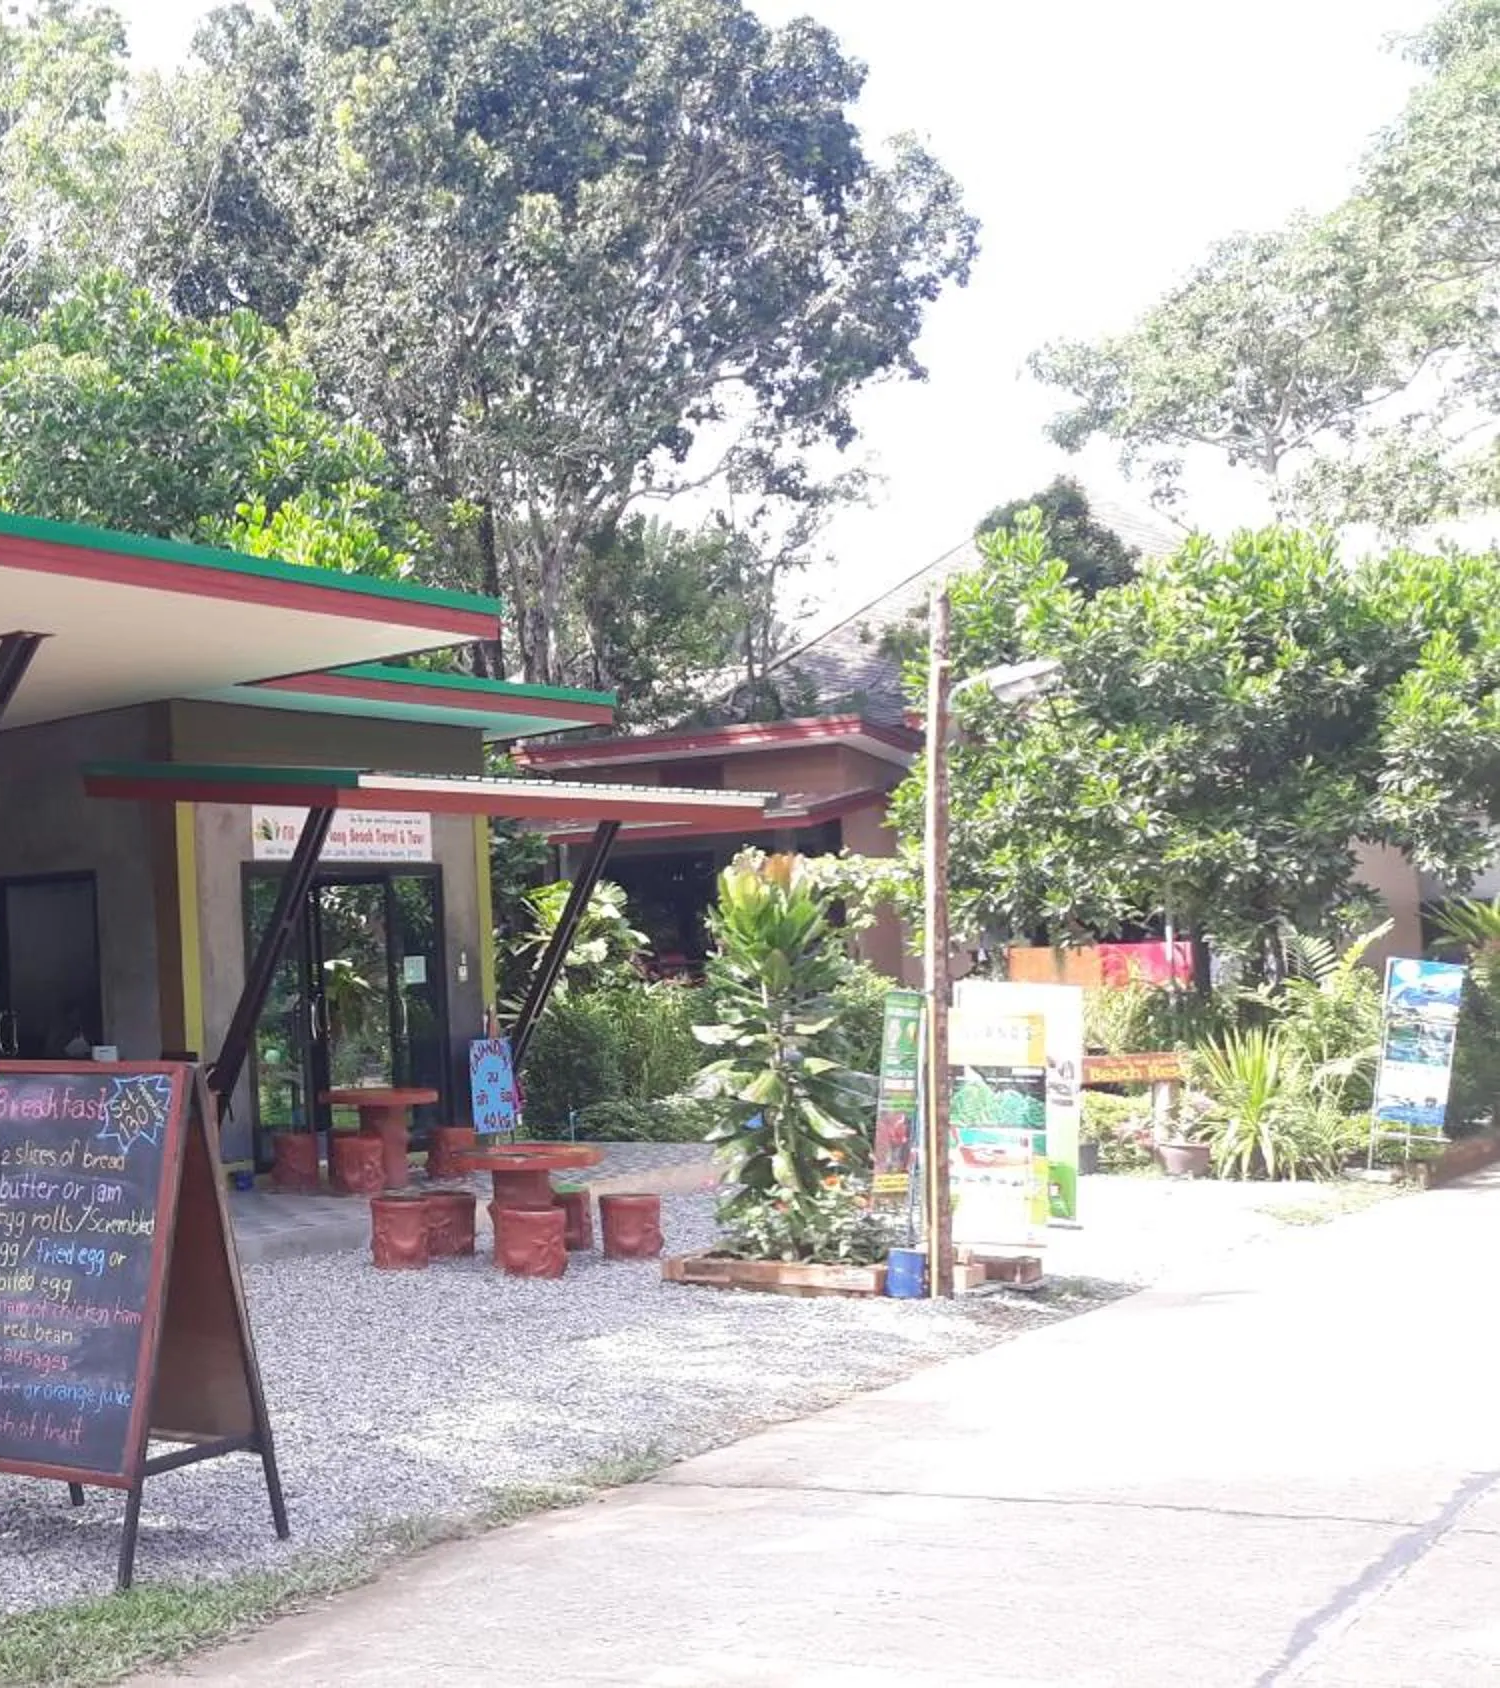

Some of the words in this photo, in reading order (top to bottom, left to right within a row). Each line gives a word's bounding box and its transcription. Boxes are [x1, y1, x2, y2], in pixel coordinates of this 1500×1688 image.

[118, 1104, 149, 1140] 130
[1, 1148, 11, 1166] 2
[15, 1139, 57, 1167] slices
[59, 1139, 81, 1168] of
[0, 1172, 60, 1200] butter
[62, 1181, 85, 1200] or
[82, 1182, 123, 1210] jam
[77, 1246, 105, 1277] egg
[108, 1250, 128, 1268] or
[39, 1277, 73, 1304] egg
